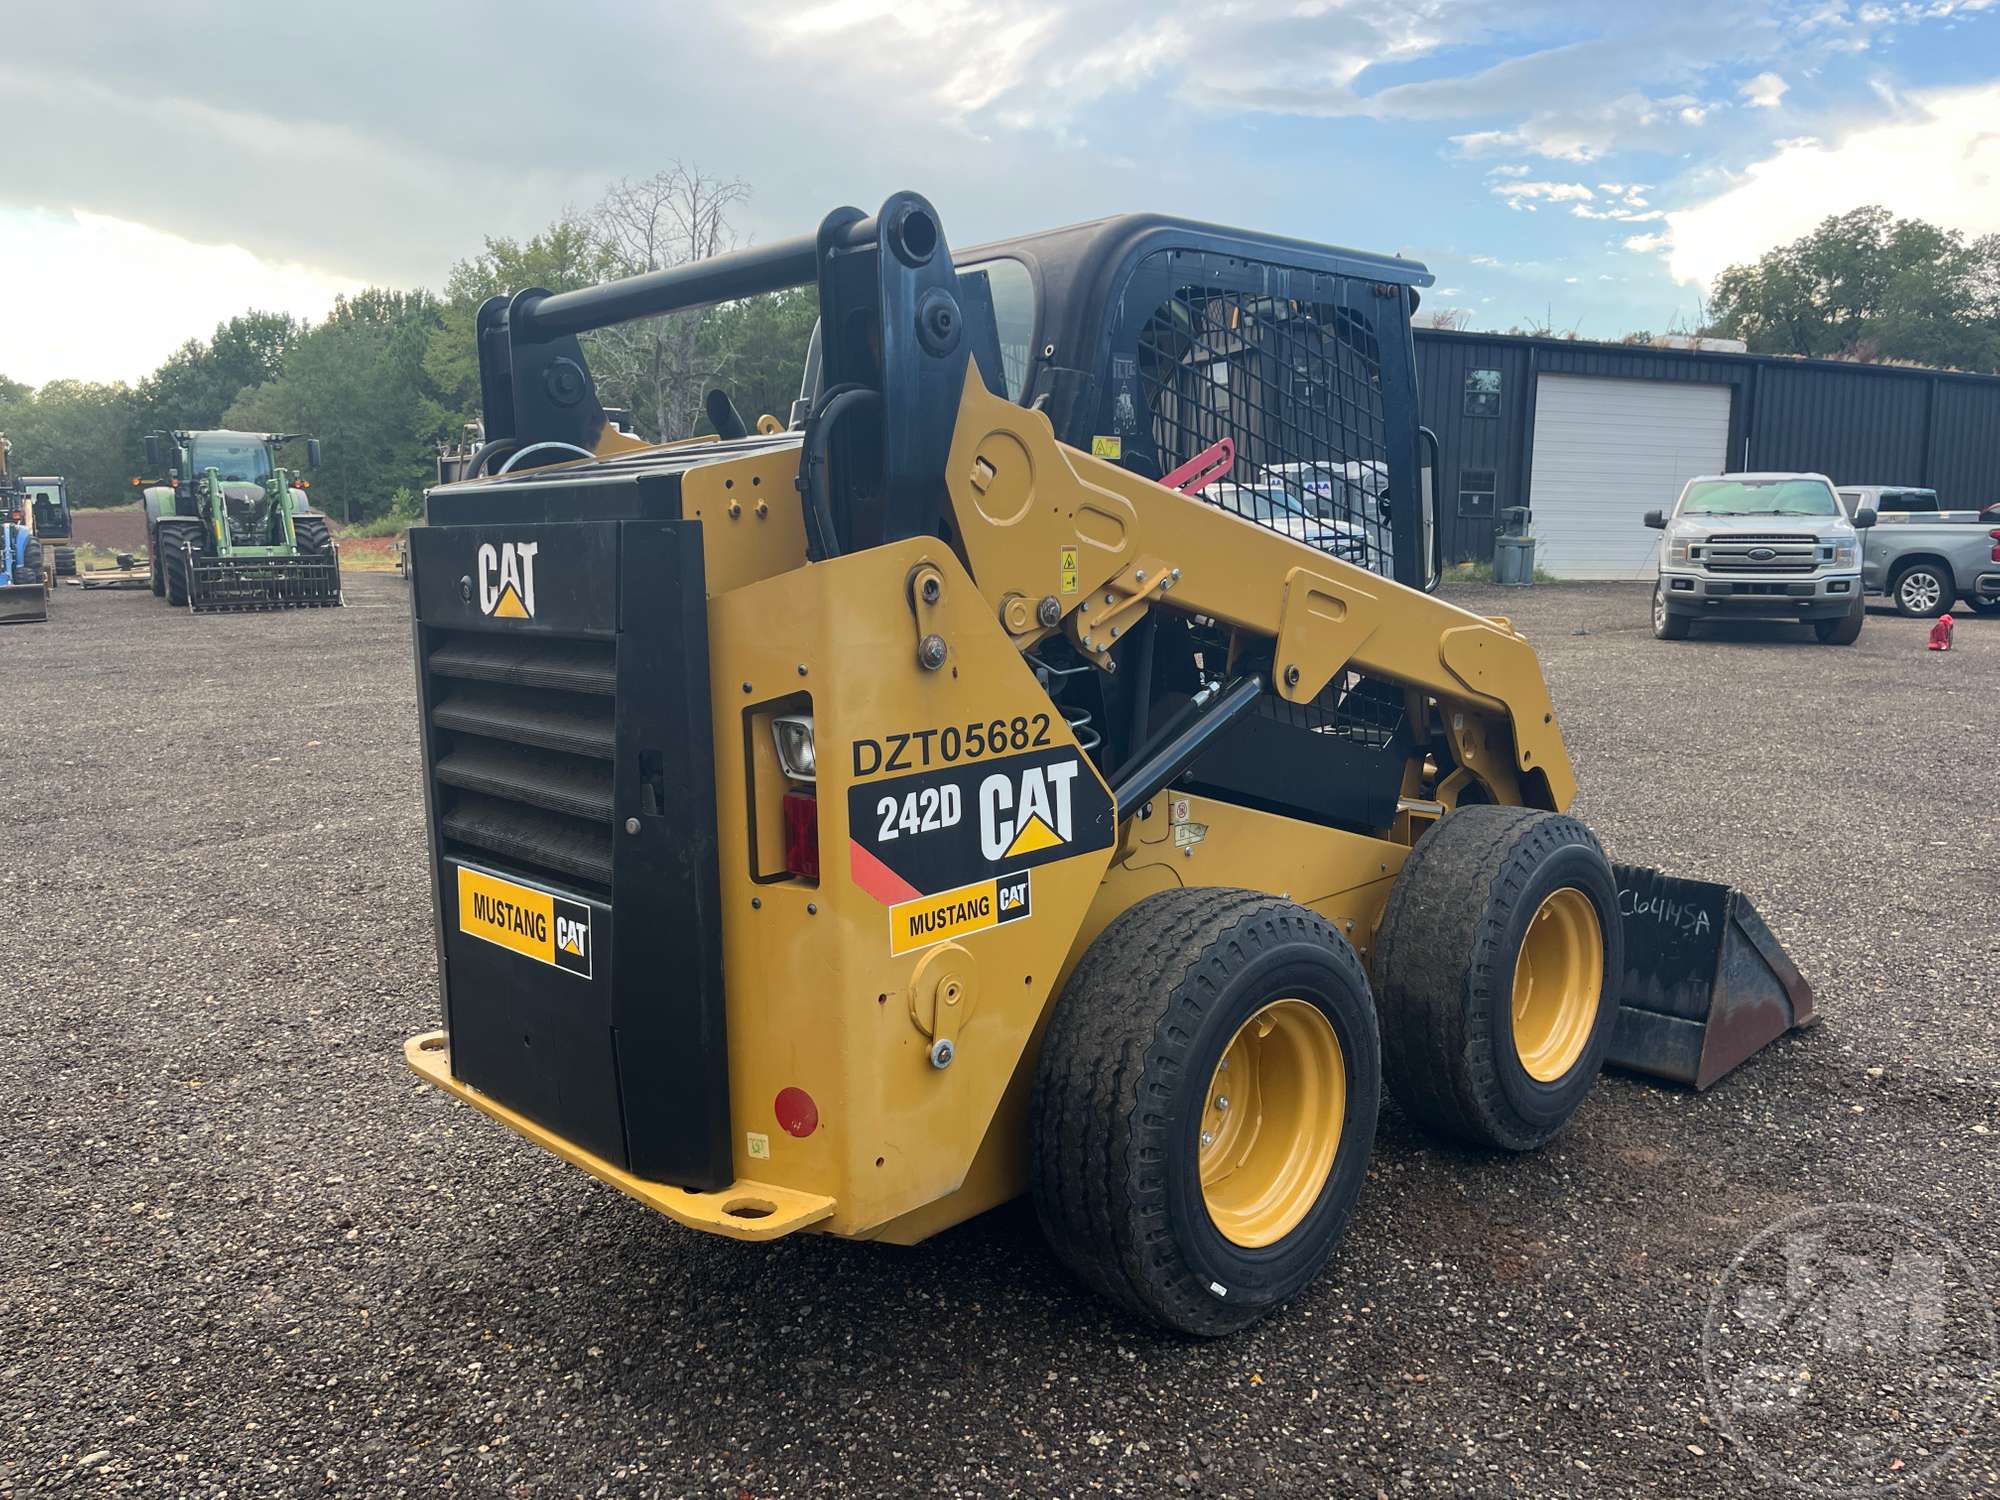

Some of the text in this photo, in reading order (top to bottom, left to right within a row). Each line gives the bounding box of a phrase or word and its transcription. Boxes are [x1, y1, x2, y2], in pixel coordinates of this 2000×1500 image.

[478, 541, 538, 618] CAT
[852, 713, 1051, 777] DZT05682
[877, 784, 962, 842] 242D
[979, 760, 1078, 861] CAT
[474, 892, 587, 957] MUSTANG CAT
[909, 883, 1027, 937] MUSTANG CAT
